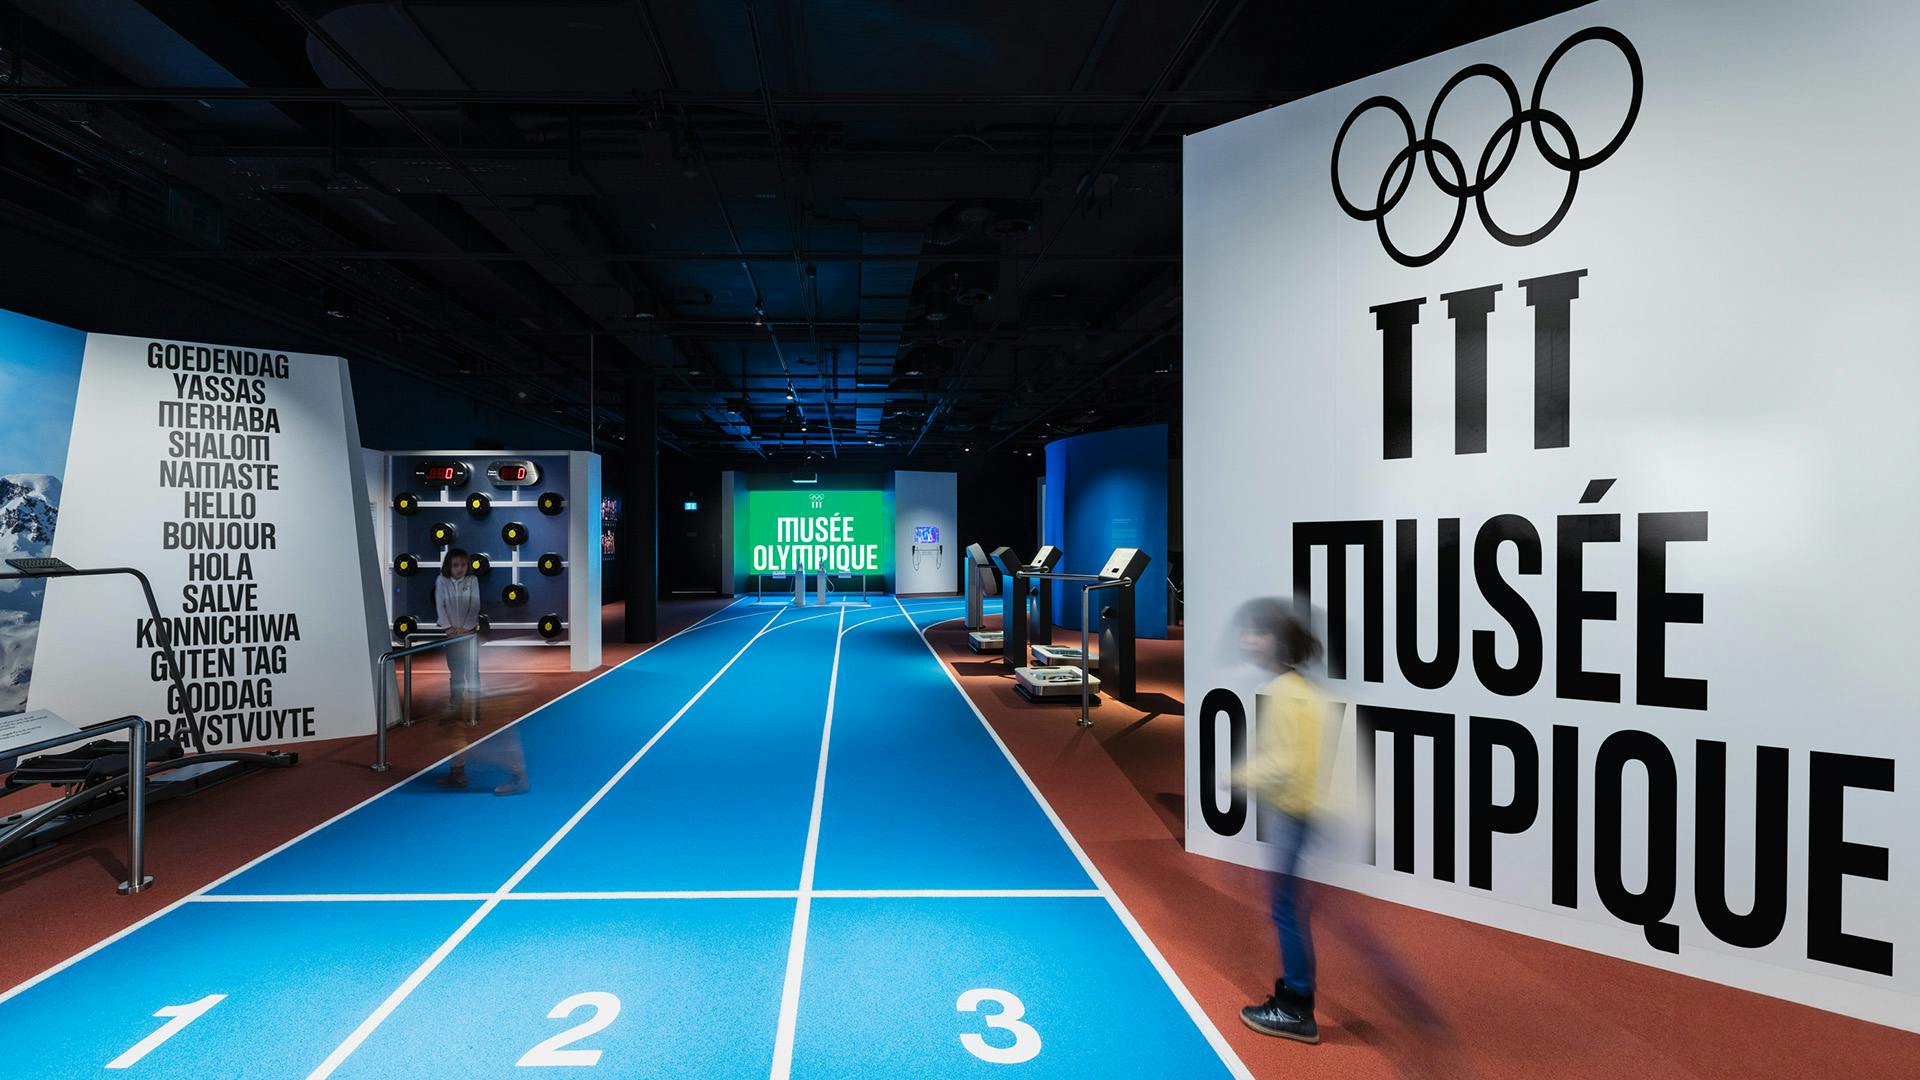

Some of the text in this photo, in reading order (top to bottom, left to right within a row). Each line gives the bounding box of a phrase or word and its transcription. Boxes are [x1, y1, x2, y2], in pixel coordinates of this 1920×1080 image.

[148, 342, 290, 381] GOEDENDAG
[173, 373, 266, 405] YASSAS
[159, 400, 281, 434] MERHABA
[168, 430, 270, 462] SHALOM
[160, 460, 279, 491] NAMASTE
[184, 491, 257, 520] HELLO
[163, 521, 277, 550] BONJOUR
[777, 512, 855, 543] MUSÉE
[188, 552, 254, 581] HOLA
[753, 544, 879, 572] OLYMPIQUE
[182, 583, 259, 614] SALVE
[1293, 478, 1709, 712] MUSÉE
[136, 613, 301, 649] KONNICHIWA
[151, 644, 287, 682] GUTEN TAG
[167, 677, 273, 715] GODDAG
[1199, 687, 1896, 978] OMPIQUE
[105, 993, 229, 1069] 1
[514, 990, 624, 1069] 2
[955, 987, 1042, 1065] 3
